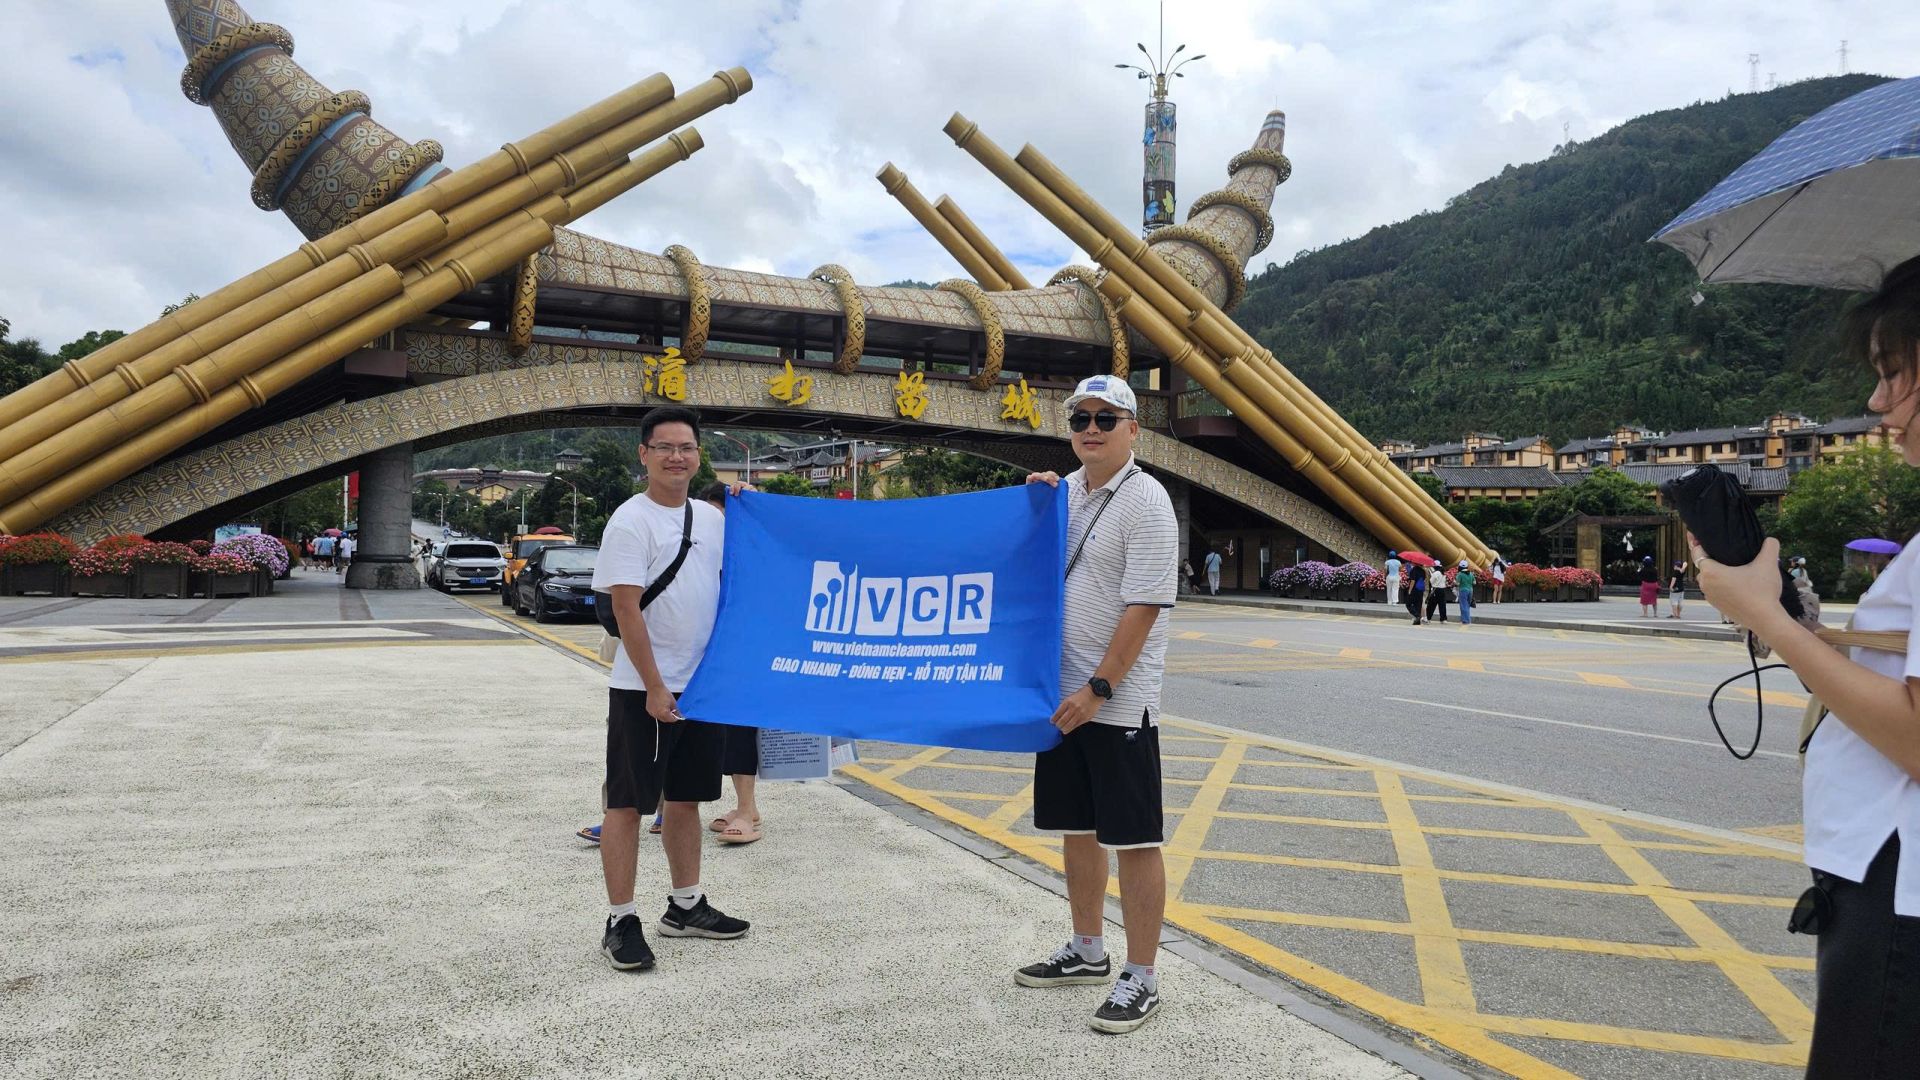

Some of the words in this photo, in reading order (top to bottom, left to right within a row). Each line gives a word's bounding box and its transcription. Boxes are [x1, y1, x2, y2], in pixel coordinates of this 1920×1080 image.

[865, 582, 987, 624] VCR
[812, 640, 977, 658] www.vietnamcleanroom.com
[771, 656, 800, 673] GIAO
[800, 660, 842, 677] NHANH
[848, 662, 881, 680] ĐÚNG
[881, 666, 906, 683] HẸN
[913, 660, 932, 681] HỖ
[932, 664, 956, 684] TRỢ
[956, 662, 978, 684] TẬN
[980, 662, 1004, 681] TÂM
